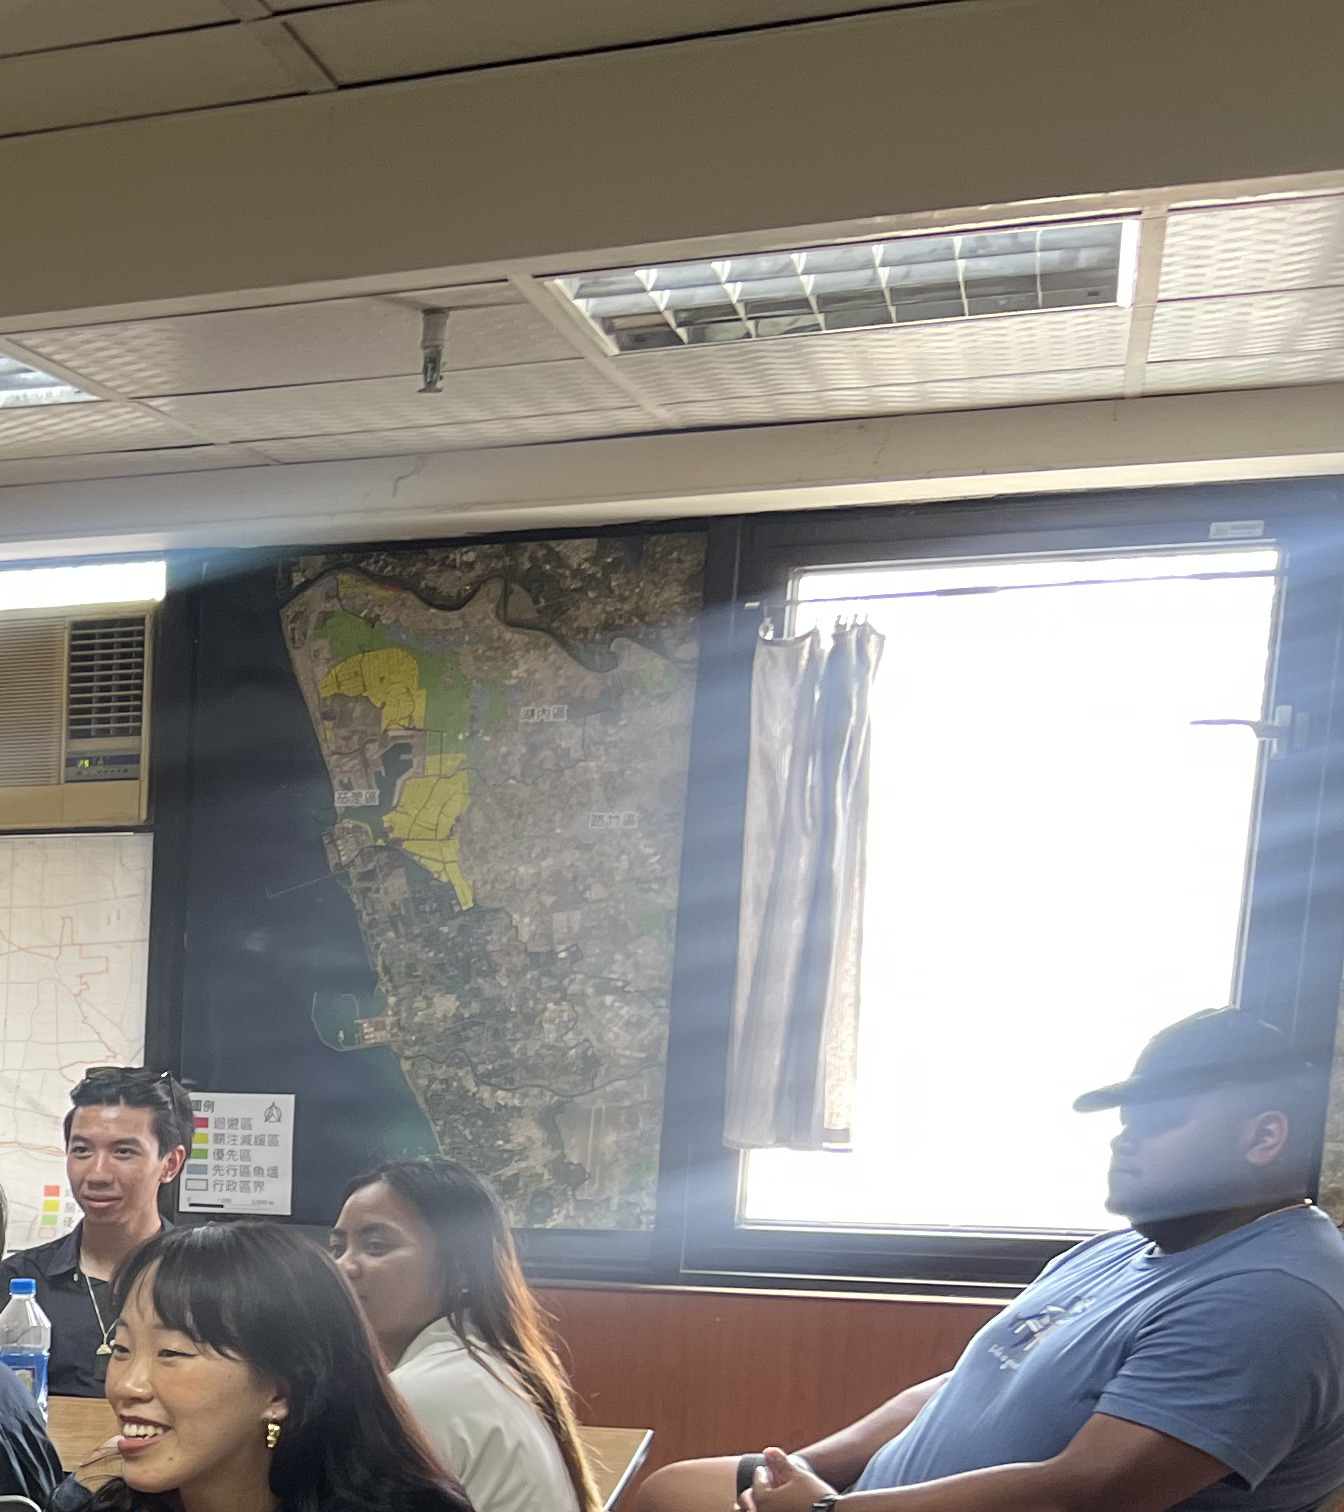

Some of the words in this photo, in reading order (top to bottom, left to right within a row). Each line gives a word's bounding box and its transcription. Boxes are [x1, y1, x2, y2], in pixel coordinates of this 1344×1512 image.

[213, 1148, 252, 1163] 優先區
[212, 1179, 265, 1194] 行政區界
